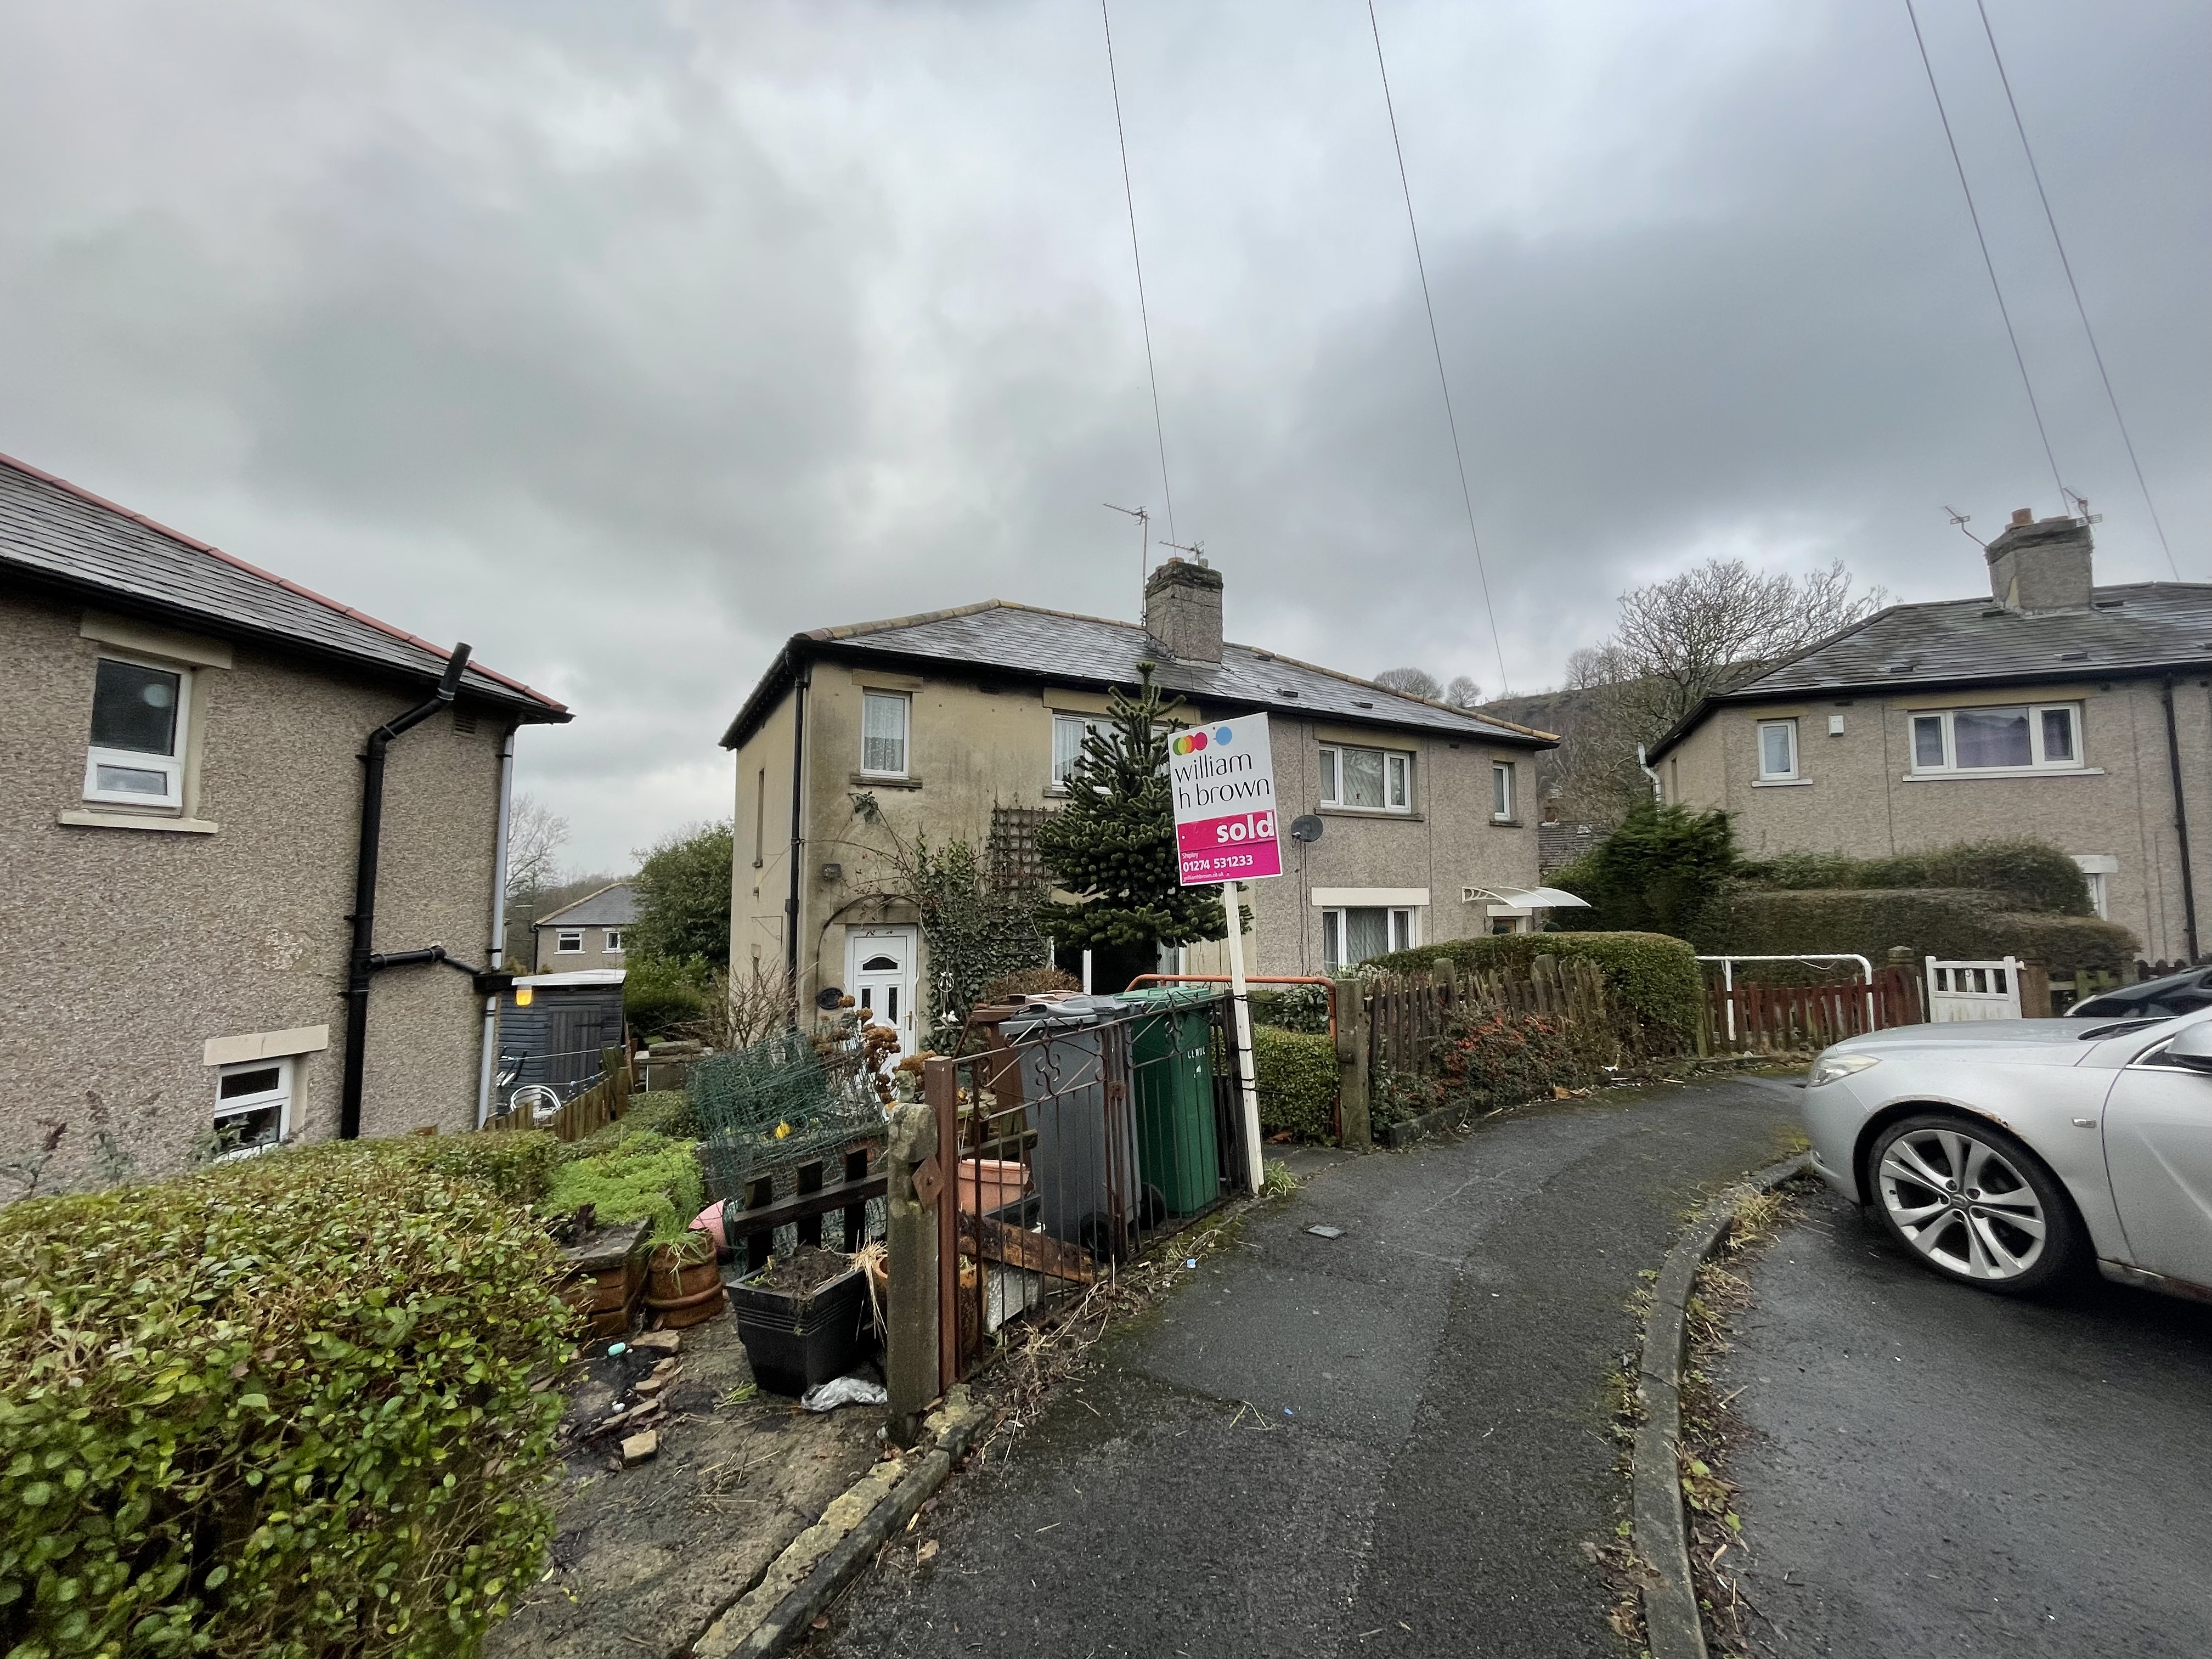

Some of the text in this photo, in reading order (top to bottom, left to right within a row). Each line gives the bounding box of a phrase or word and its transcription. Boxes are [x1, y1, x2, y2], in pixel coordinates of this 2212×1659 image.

[1175, 753, 1252, 783] william
[1179, 778, 1270, 809] h brown
[1216, 812, 1275, 843] sold
[1183, 854, 1254, 872] 01274 531233
